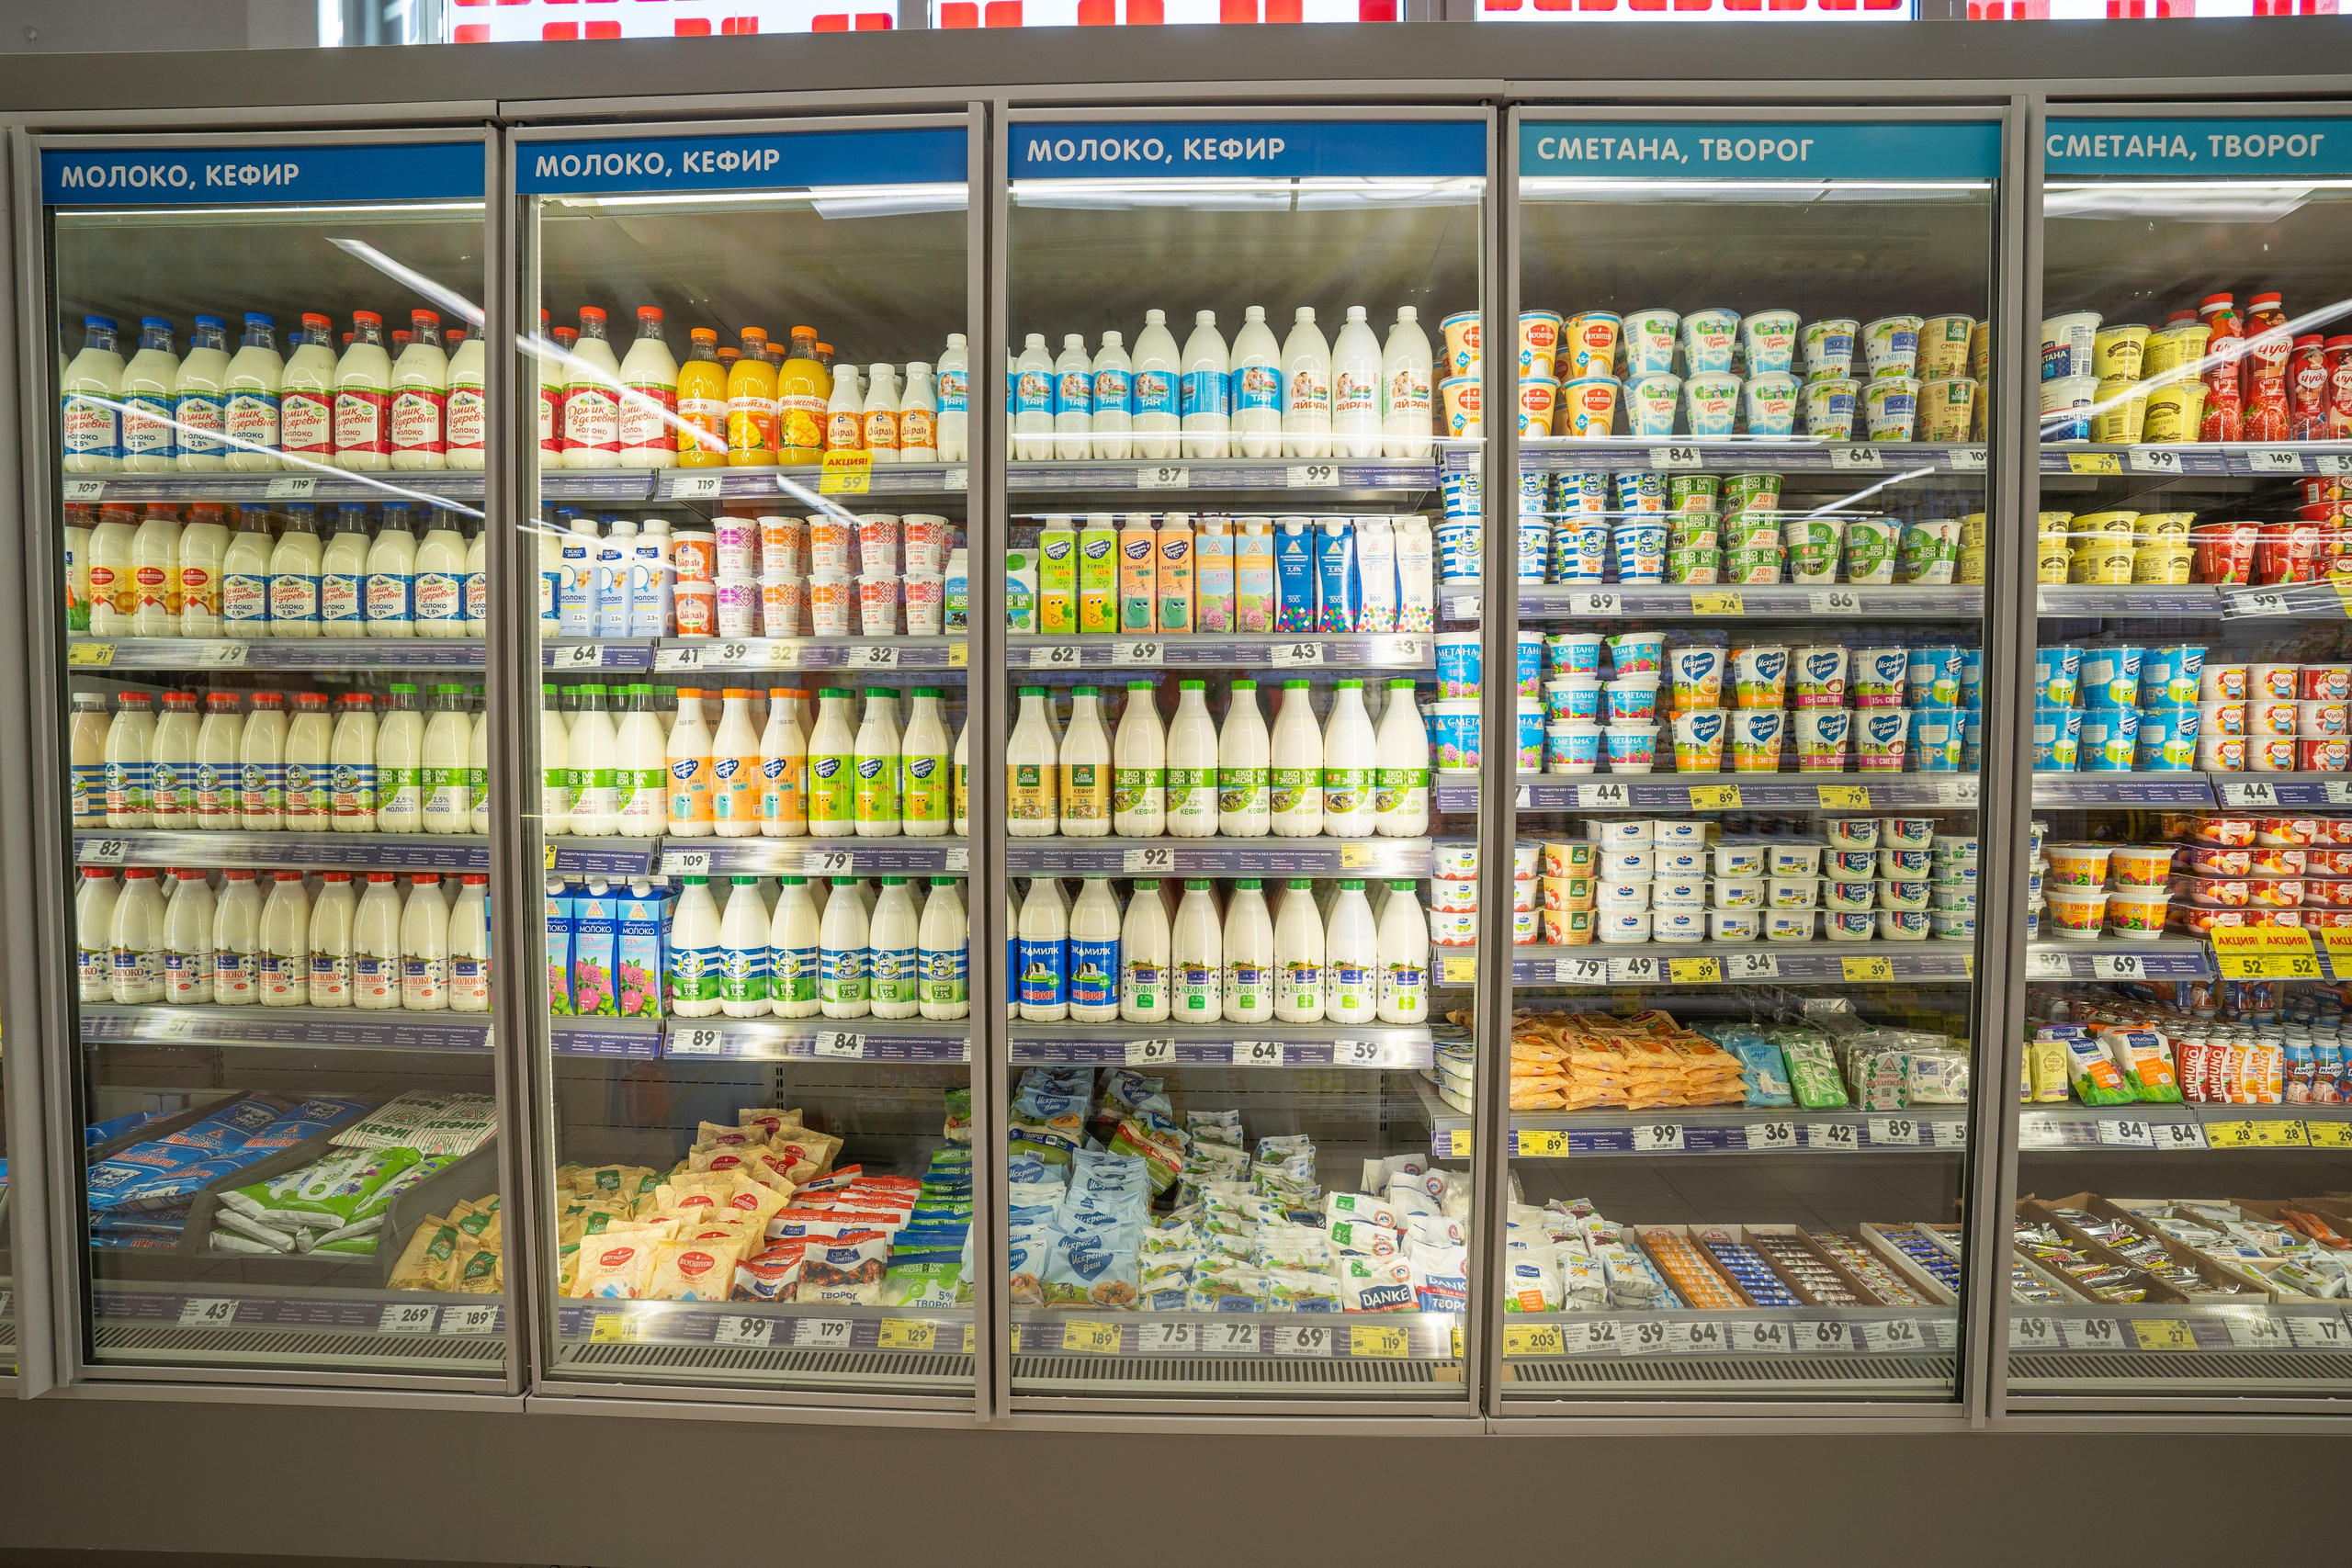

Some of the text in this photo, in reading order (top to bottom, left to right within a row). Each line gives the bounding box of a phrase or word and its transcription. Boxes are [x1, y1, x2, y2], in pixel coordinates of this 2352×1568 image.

[1027, 136, 1285, 164] МОЛОКО, КЕФИР
[1536, 137, 1814, 165] СМЕТАНА, ТВОРОГ
[2046, 132, 2324, 162] СМЕТАНА, ТВОРОГ
[536, 148, 781, 177] МОЛОКО, КЕФИР
[61, 163, 300, 189] МОЛОКО, КЕФИР
[568, 405, 605, 418] Домик
[1293, 400, 1328, 411] АЙРАН
[1394, 400, 1430, 410] АЙРАН
[1669, 448, 1693, 461] 84
[1850, 449, 1874, 461] 64
[2149, 452, 2173, 467] 99
[2269, 454, 2292, 464] 149
[827, 458, 868, 467] АКЦИЯ!
[2098, 460, 2112, 469] 79
[1159, 468, 1181, 481] 87
[1307, 466, 1331, 479] 99
[78, 483, 96, 492] 109
[292, 480, 309, 489] 119
[697, 480, 714, 490] 119
[842, 477, 861, 489] 59
[1758, 495, 1774, 503] 20%
[1757, 568, 1773, 576] 20%
[1590, 594, 1612, 608] 89
[1720, 601, 1736, 610] 74
[1829, 592, 1852, 606] 86
[2253, 595, 2278, 608] 99
[96, 652, 107, 660] 91
[219, 647, 242, 660] 79
[573, 646, 596, 660] 64
[679, 649, 698, 662] 41
[723, 644, 746, 659] 39
[770, 646, 791, 660] 32
[869, 648, 891, 662] 32
[1051, 648, 1074, 661] 62
[1133, 643, 1156, 658] 69
[1292, 644, 1316, 660] 43
[1683, 656, 1713, 668] Искренне
[1691, 666, 1706, 674] Ваш
[1817, 695, 1839, 704] СМЕТАНА
[1597, 785, 1622, 800] 44
[1720, 793, 1733, 803] 89
[2244, 784, 2267, 798] 44
[1848, 794, 1861, 803] 79
[99, 841, 121, 856] 82
[684, 855, 703, 866] 109
[824, 854, 846, 868] 79
[1145, 850, 1167, 864] 92
[2219, 936, 2258, 946] АКЦИЯ!
[2266, 936, 2308, 945] АКЦИЯ!
[1576, 961, 1600, 976] 79
[1628, 959, 1652, 974] 49
[1746, 954, 1770, 971] 34
[2113, 957, 2136, 972] 69
[2243, 961, 2264, 974] 52
[2293, 959, 2313, 973] 52
[1699, 966, 1712, 976] 39
[1871, 965, 1885, 976] 39
[1131, 985, 1160, 994] КЕФИР
[692, 1031, 715, 1046] 89
[834, 1033, 857, 1050] 84
[1145, 1040, 1167, 1056] 67
[1252, 1043, 1276, 1058] 64
[1354, 1043, 1378, 1058] 59
[2189, 1047, 2199, 1099] IMMUNO
[2258, 1048, 2267, 1099] IMMUNO
[1038, 1097, 1068, 1105] Искренне
[424, 1121, 487, 1129] КЕФИР
[1765, 1123, 1788, 1140] 36
[1889, 1121, 1911, 1136] 89
[2119, 1122, 2143, 1137] 84
[1653, 1126, 1676, 1142] 99
[1828, 1126, 1851, 1141] 42
[2172, 1125, 2196, 1141] 84
[2235, 1130, 2251, 1140] 28
[2285, 1129, 2300, 1139] 28
[1547, 1140, 1561, 1150] 89
[1083, 1261, 1101, 1272] Ваш
[939, 1292, 954, 1300] 5%
[1363, 1288, 1408, 1306] DANKE
[205, 1303, 228, 1319] 43
[401, 1309, 428, 1322] 269
[467, 1312, 488, 1325] 189
[741, 1318, 765, 1337] 99
[821, 1323, 843, 1337] 179
[1161, 1324, 1188, 1342] 75
[1227, 1325, 1252, 1343] 72
[1589, 1323, 1615, 1341] 52
[1638, 1321, 1664, 1343] 39
[1690, 1325, 1717, 1342] 64
[1754, 1323, 1781, 1343] 64
[1817, 1322, 1842, 1342] 69
[1887, 1321, 1914, 1340] 62
[2021, 1320, 2045, 1337] 49
[2086, 1320, 2111, 1338] 49
[2318, 1323, 2336, 1338] 17
[908, 1330, 927, 1341] 129
[1091, 1332, 1112, 1346] 189
[1297, 1328, 1323, 1347] 69
[1531, 1335, 1555, 1347] 203
[2168, 1331, 2184, 1342] 27
[1382, 1337, 1399, 1349] 119
